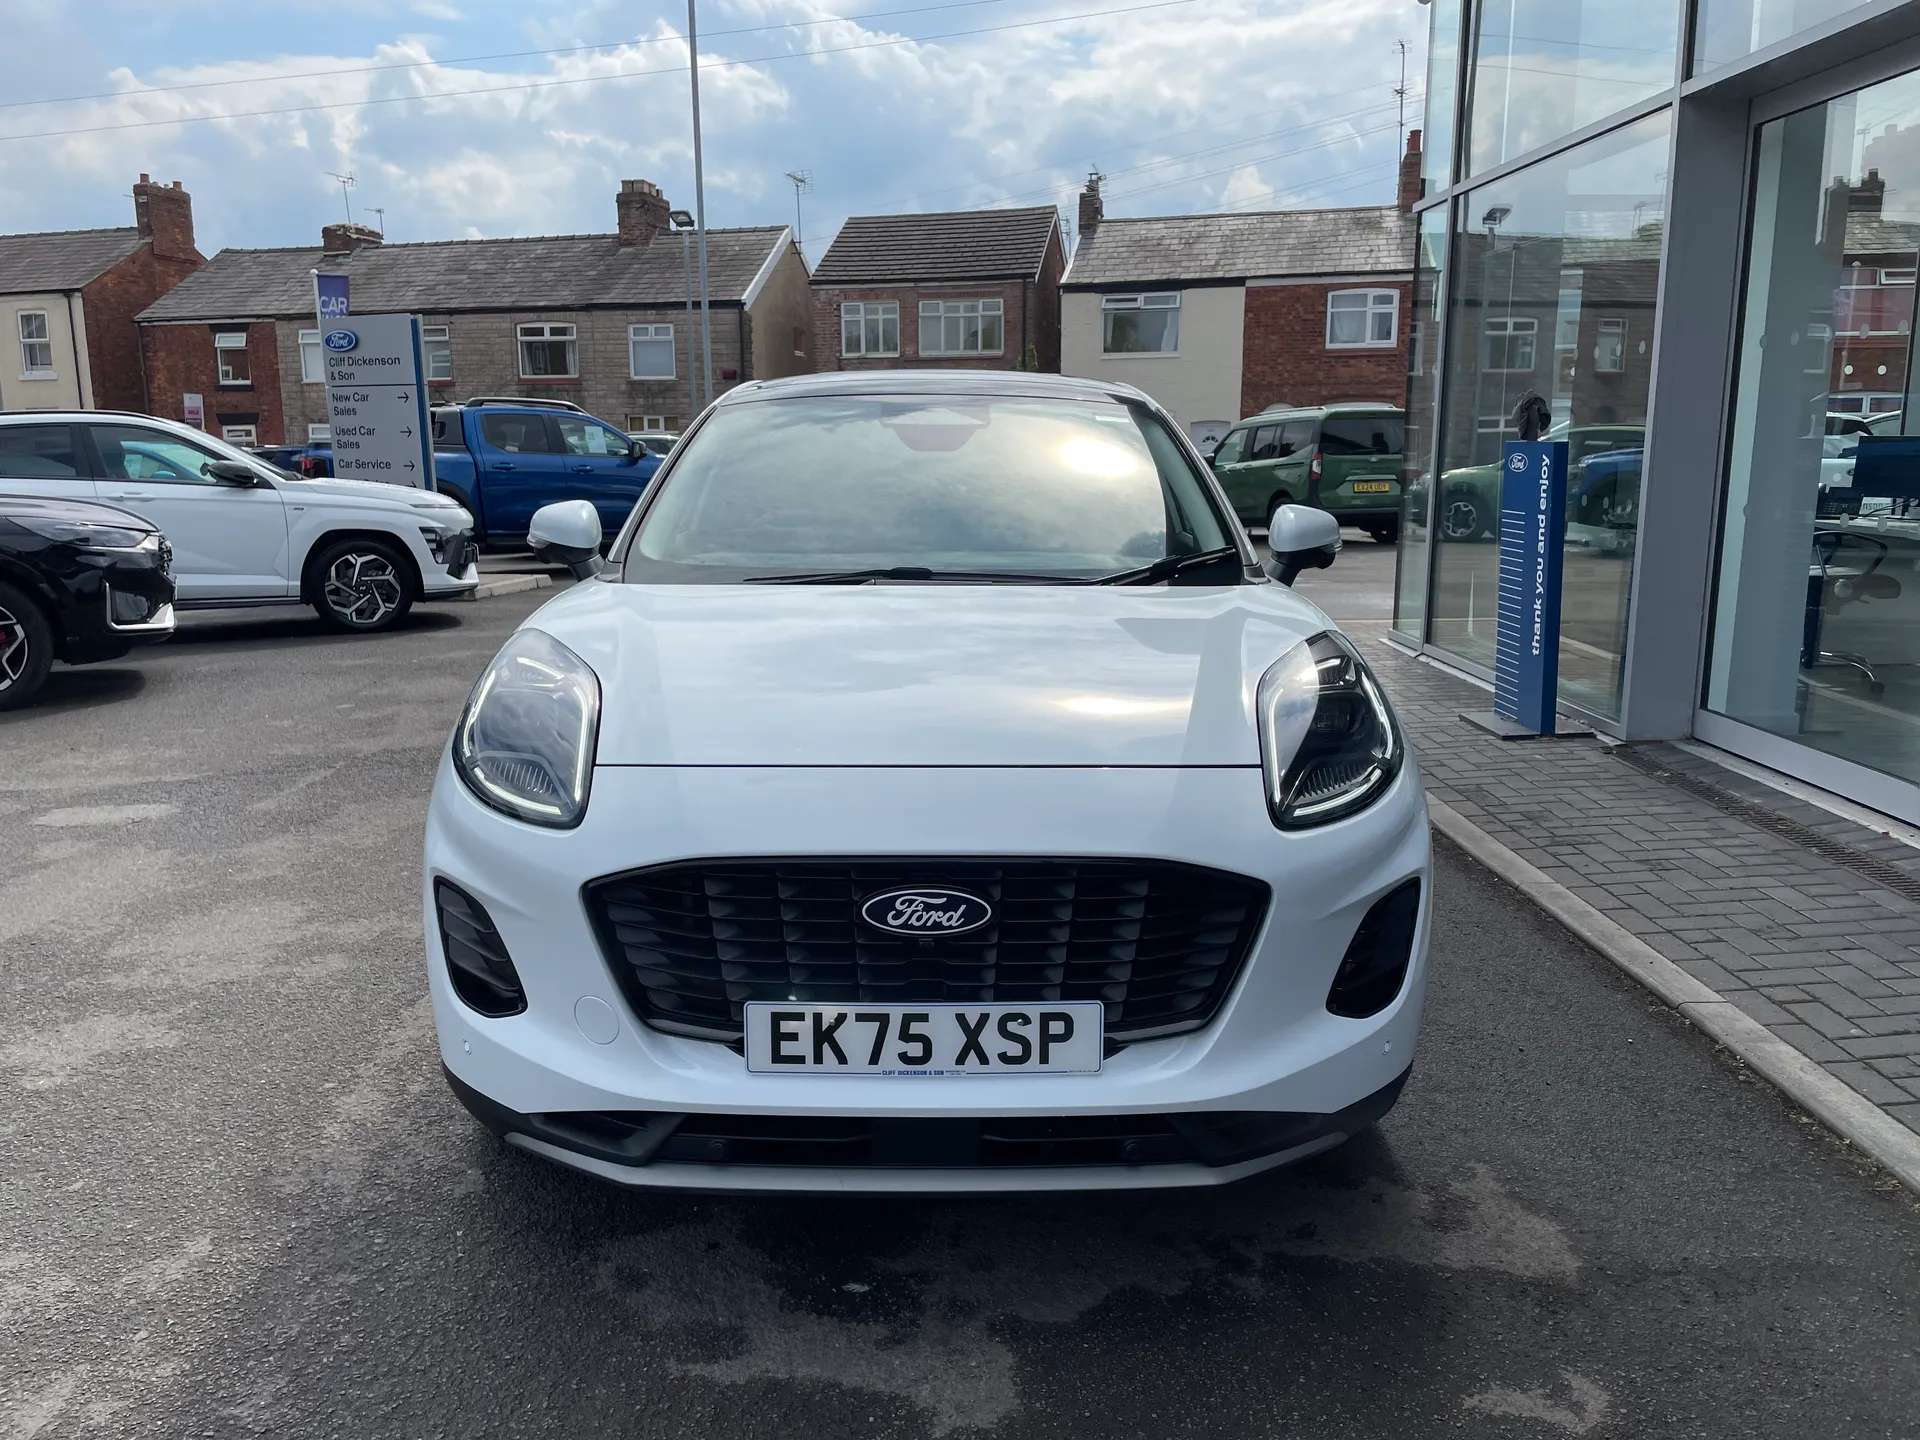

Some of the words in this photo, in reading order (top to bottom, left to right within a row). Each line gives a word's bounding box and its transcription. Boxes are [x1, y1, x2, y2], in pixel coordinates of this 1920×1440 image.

[320, 295, 347, 313] CAR
[329, 356, 346, 367] Cliff
[347, 356, 400, 366] Dickenson
[330, 371, 336, 380] &
[338, 370, 355, 380] Son
[332, 392, 350, 402] New
[353, 392, 369, 402] Car
[334, 406, 357, 416] Sales
[335, 425, 357, 436] Used
[359, 425, 376, 436] Car
[336, 439, 360, 449] Sales
[338, 459, 353, 469] Car
[354, 459, 391, 469] Service
[1539, 453, 1550, 511] enjoy
[1537, 514, 1546, 554] and
[1535, 557, 1544, 594] you
[1531, 598, 1542, 656] thank
[886, 895, 967, 927] Ford
[770, 1011, 933, 1066] EK75
[954, 1012, 1075, 1066] XSP
